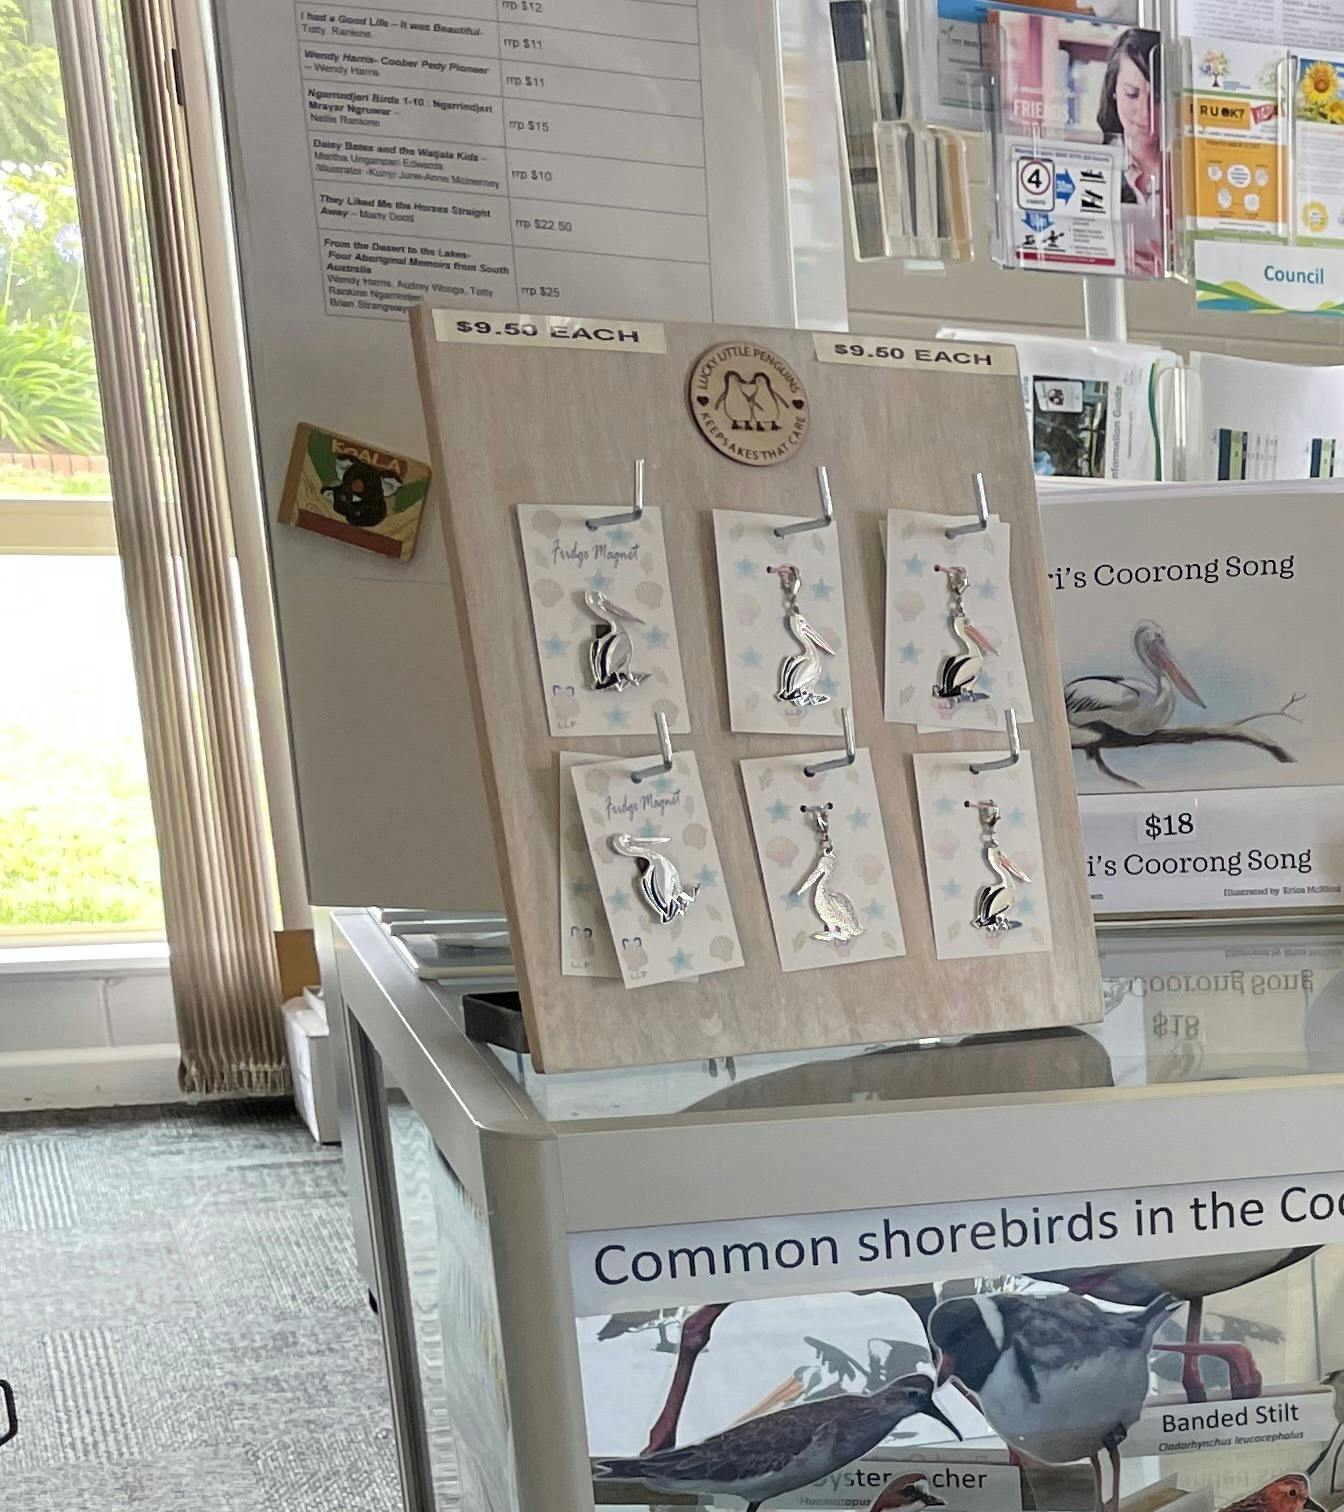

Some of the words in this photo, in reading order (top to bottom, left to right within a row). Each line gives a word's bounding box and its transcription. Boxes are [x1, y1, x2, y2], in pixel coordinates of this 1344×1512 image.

[521, 0, 543, 13] $12
[338, 14, 367, 25] Good
[369, 16, 389, 27] Life
[522, 38, 543, 49] $11
[304, 50, 339, 62] Wendy
[381, 57, 418, 68] Coober
[421, 60, 447, 72] Pedy
[314, 63, 348, 76] Wendy
[524, 76, 545, 87] $11
[527, 120, 550, 132] $15
[313, 139, 342, 151] Daisy
[377, 144, 396, 154] and
[399, 146, 415, 156] the
[456, 151, 479, 162] Kids
[530, 170, 552, 181] $10
[1027, 168, 1042, 189] 4
[320, 194, 345, 207] They
[347, 196, 375, 207] Liked
[395, 200, 411, 210] the
[413, 203, 449, 214] Horses
[451, 205, 491, 218] Straight
[320, 206, 349, 218] Away
[324, 238, 350, 249] From
[353, 240, 369, 250] the
[372, 242, 405, 254] Desert
[407, 246, 418, 254] to
[420, 246, 436, 257] the
[326, 262, 372, 274] Australia
[355, 253, 406, 267] Aboriginal
[409, 257, 451, 269] Memoirs
[453, 261, 477, 272] from
[479, 263, 510, 275] South
[1264, 265, 1325, 285] Council
[539, 287, 560, 298] $25
[456, 319, 538, 337] $9.50
[550, 326, 640, 343] EACH
[833, 343, 905, 360] $9.50
[914, 348, 993, 367] EACH
[697, 357, 720, 390] LUCKY
[752, 348, 801, 395] PENGUINS
[1113, 385, 1123, 418] Guide
[551, 540, 590, 563] Fudge
[592, 541, 640, 562] Magnet
[1094, 559, 1219, 585] Coorong
[1226, 555, 1295, 580] Song
[604, 794, 640, 815] Fudge
[642, 789, 681, 812] Magnet
[1144, 812, 1194, 840] $18
[1124, 851, 1241, 877] Coorong
[1248, 849, 1312, 874] Song
[594, 1230, 839, 1286] Common
[857, 1202, 1119, 1263] shorebirds
[1135, 1199, 1174, 1237] in
[1189, 1190, 1264, 1232] the
[1162, 1406, 1249, 1433] Banded
[1256, 1402, 1300, 1424] Stilt
